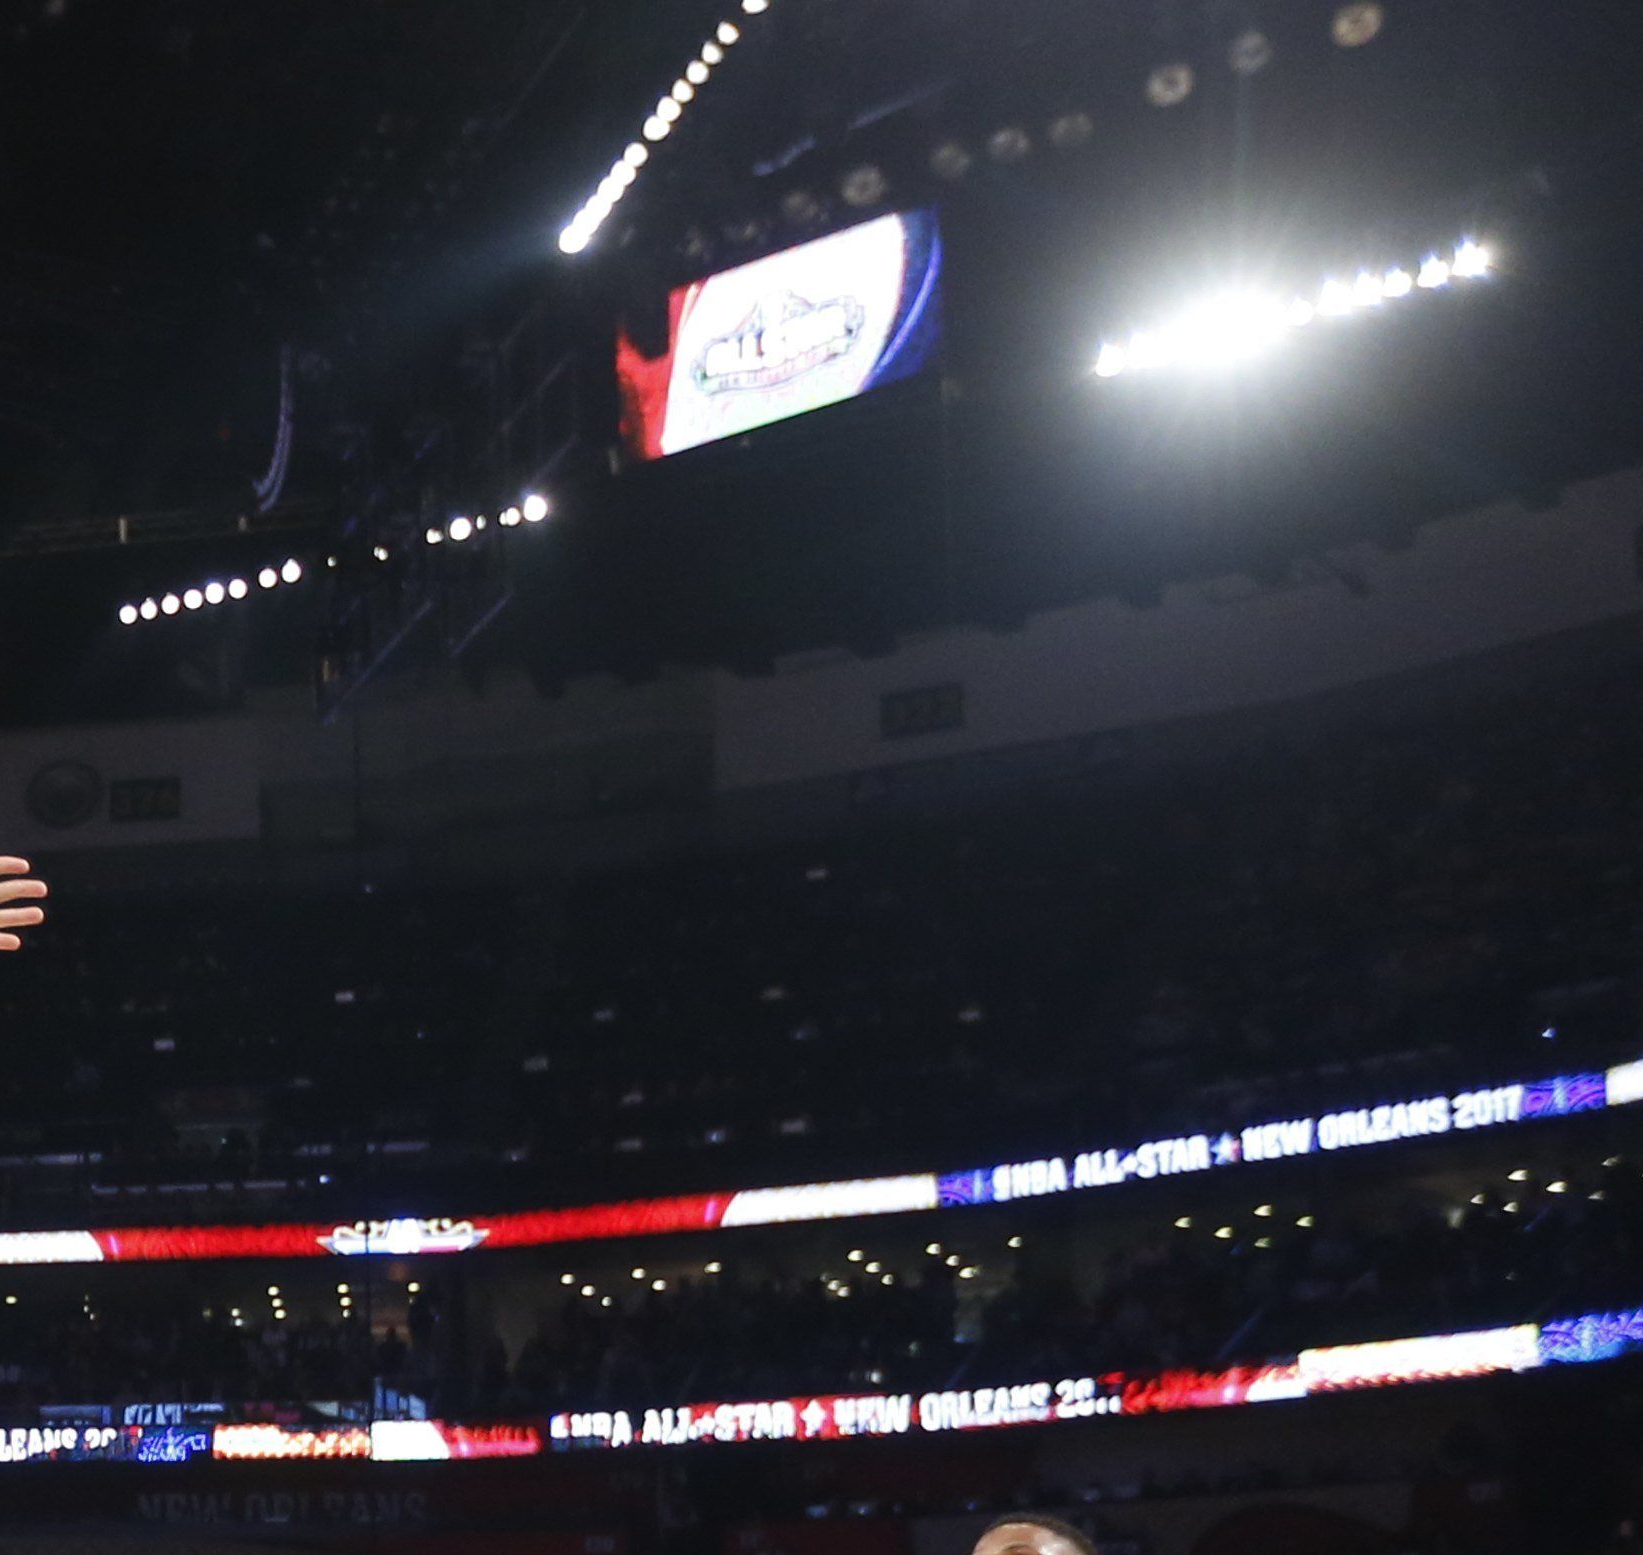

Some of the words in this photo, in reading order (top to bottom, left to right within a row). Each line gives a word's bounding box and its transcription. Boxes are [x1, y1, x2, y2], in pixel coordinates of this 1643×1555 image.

[1008, 1158, 1067, 1200] NBA
[1242, 1117, 1312, 1160] NEW
[1318, 1096, 1450, 1150] ORLEANS
[1452, 1085, 1523, 1130] 2017
[919, 1383, 1051, 1432] ORLEANS
